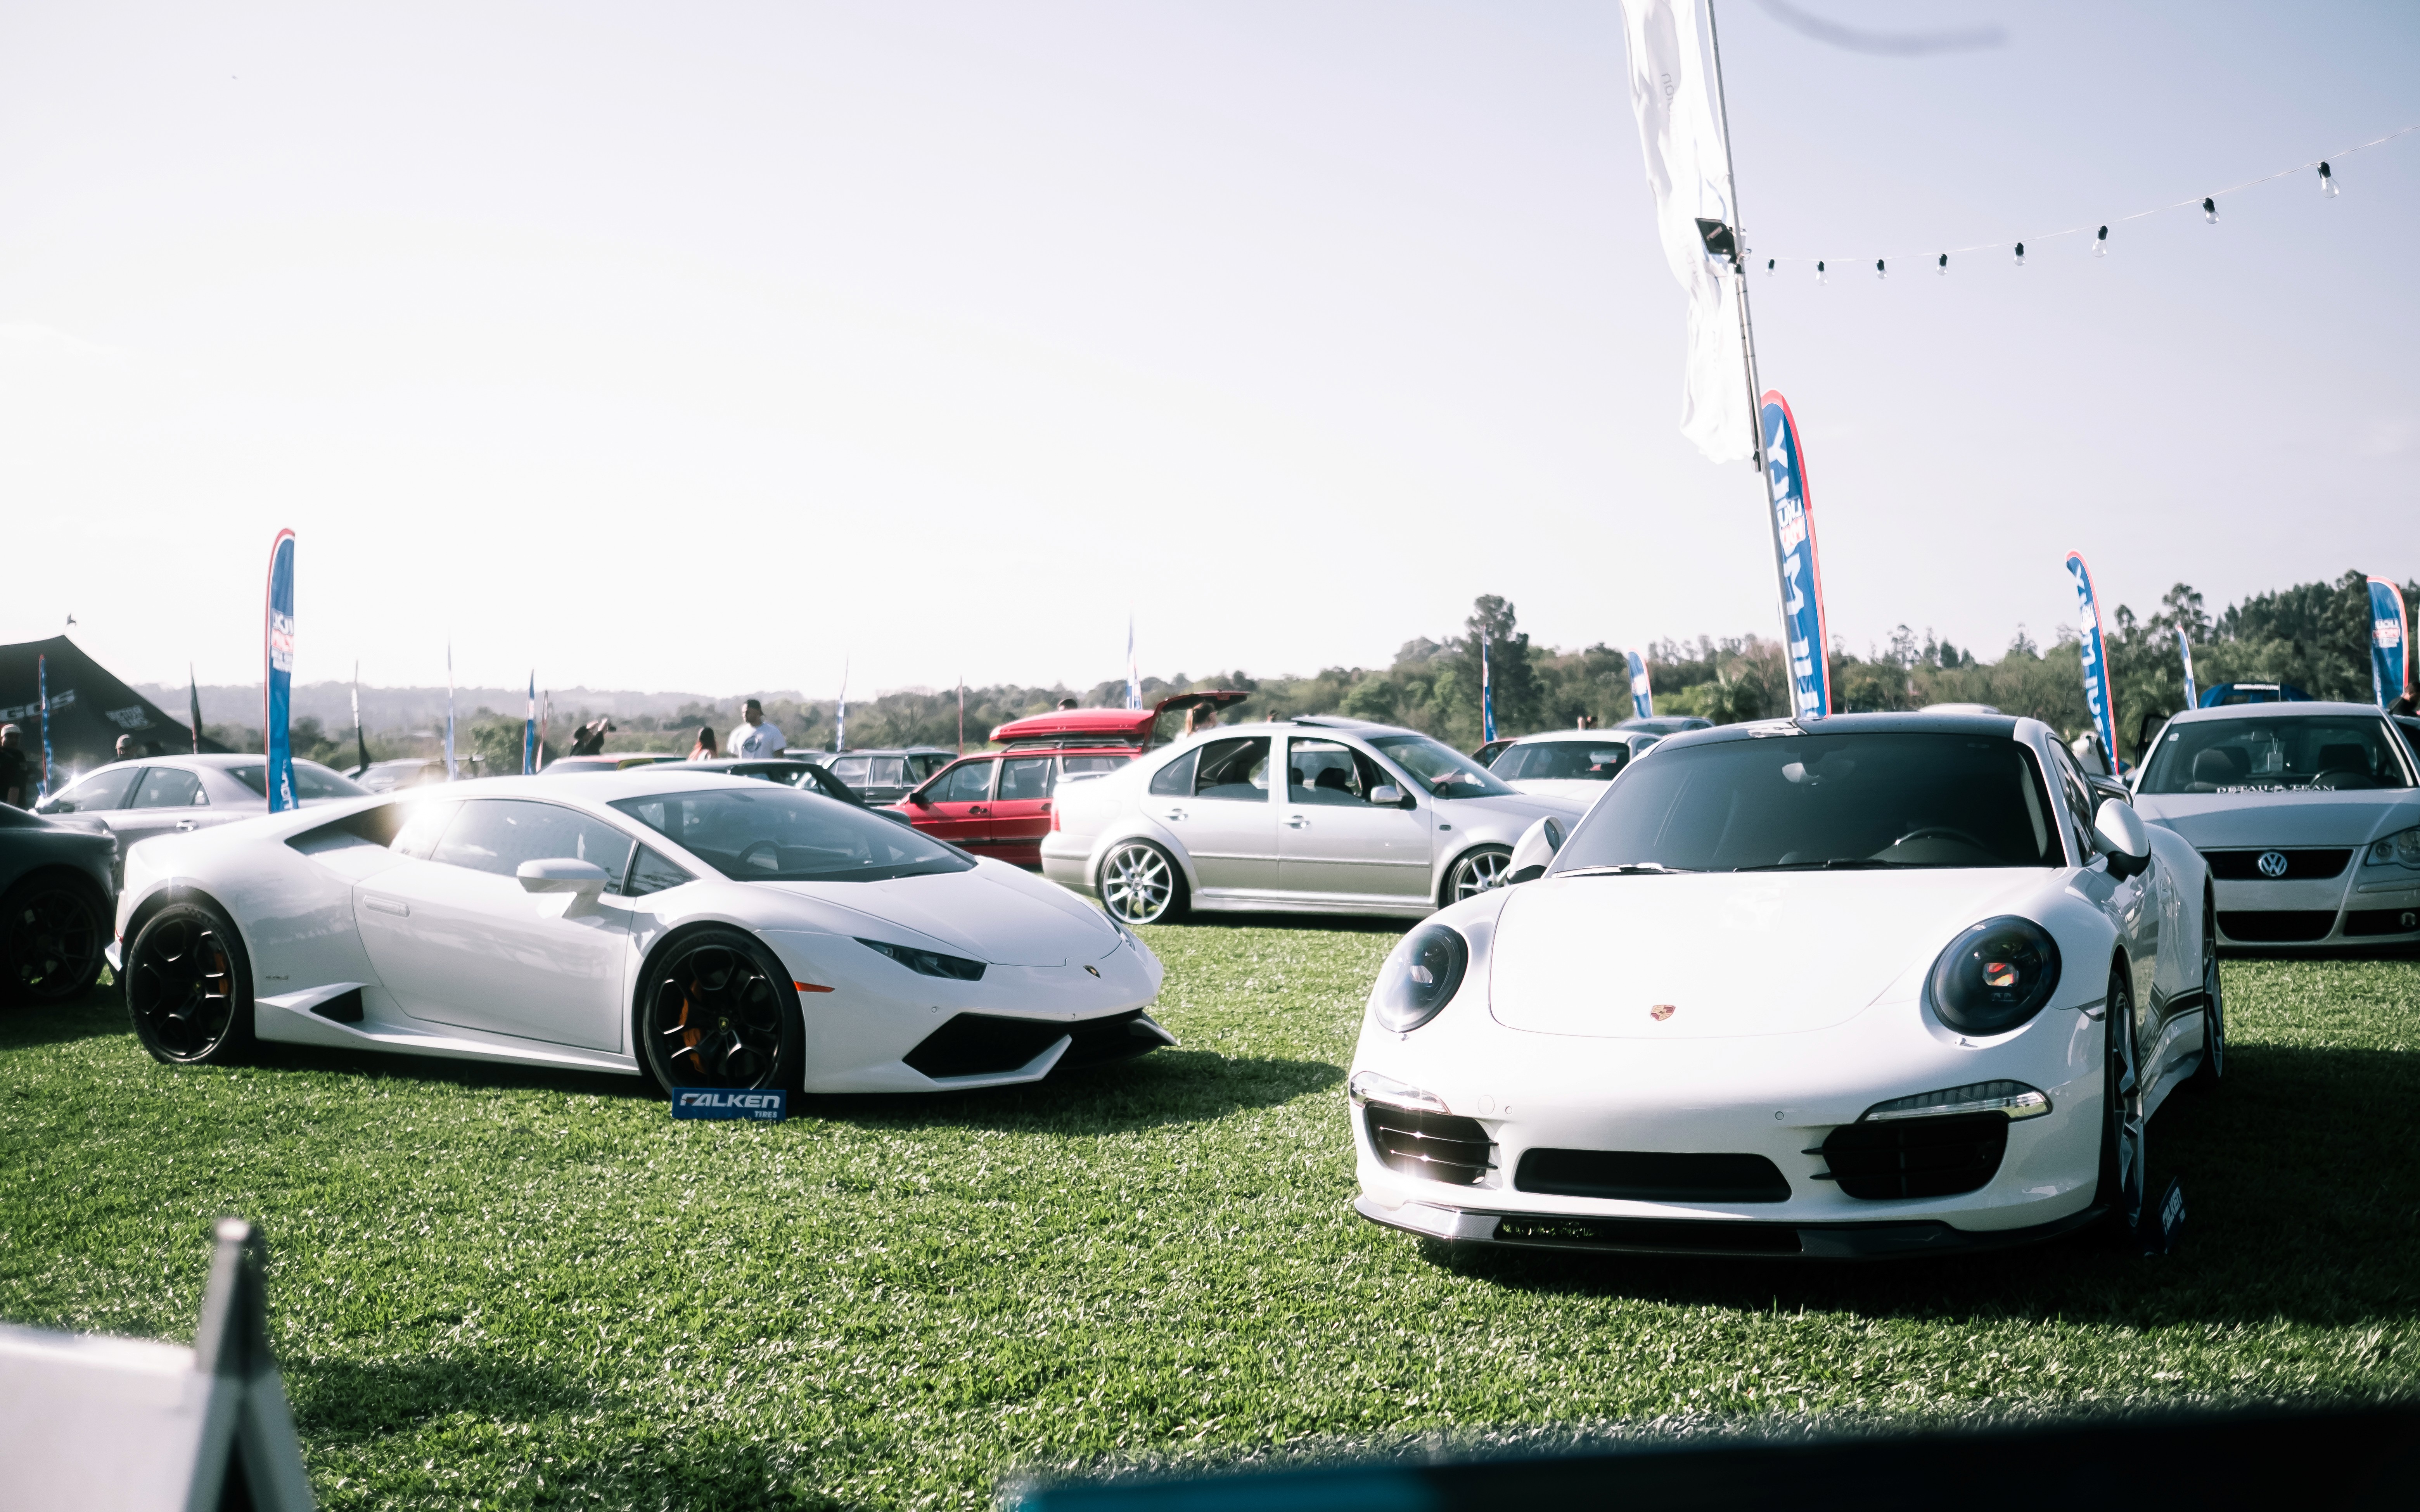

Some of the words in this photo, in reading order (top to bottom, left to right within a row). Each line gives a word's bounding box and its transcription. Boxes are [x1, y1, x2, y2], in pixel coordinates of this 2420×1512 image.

[2258, 852, 2288, 877] VW
[680, 1092, 781, 1109] FALKEN
[754, 1110, 778, 1118] TIRES
